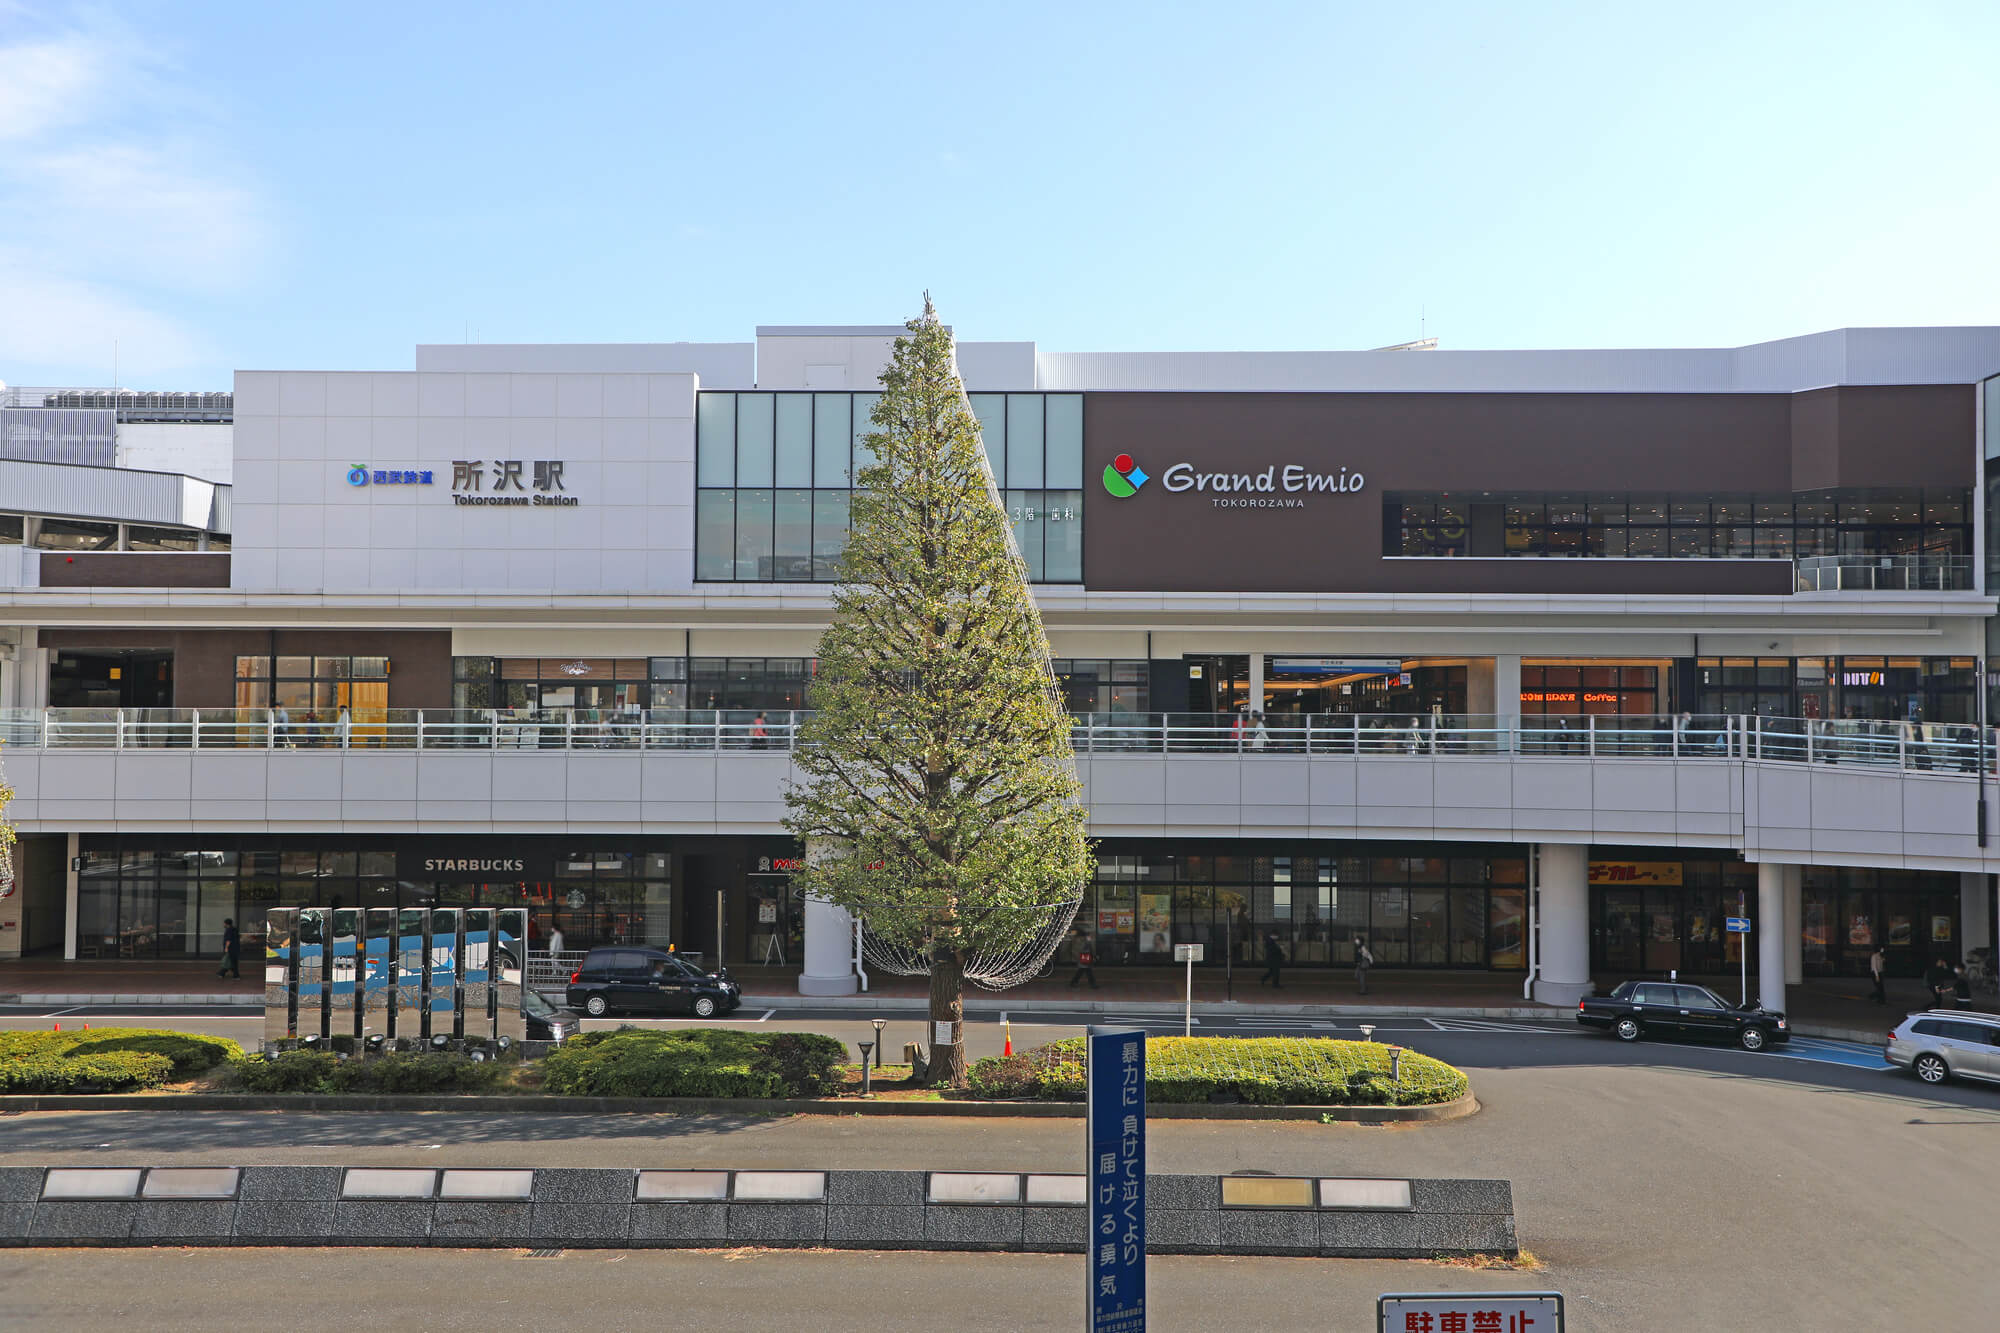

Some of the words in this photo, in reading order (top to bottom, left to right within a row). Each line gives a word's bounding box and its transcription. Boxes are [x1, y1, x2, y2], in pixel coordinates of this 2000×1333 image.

[373, 470, 433, 484] 西武鉄道
[452, 460, 565, 491] 所沢駅
[1162, 463, 1275, 493] Grand
[1282, 464, 1365, 493] Emio
[452, 494, 529, 506] Tokorozawa
[532, 494, 578, 506] Station
[1212, 498, 1305, 508] TOKOROZAWA
[424, 859, 524, 871] STARBUCKS
[1099, 1152, 1116, 1297] 届ける勇気
[1405, 1310, 1535, 1333] 駐車禁止
